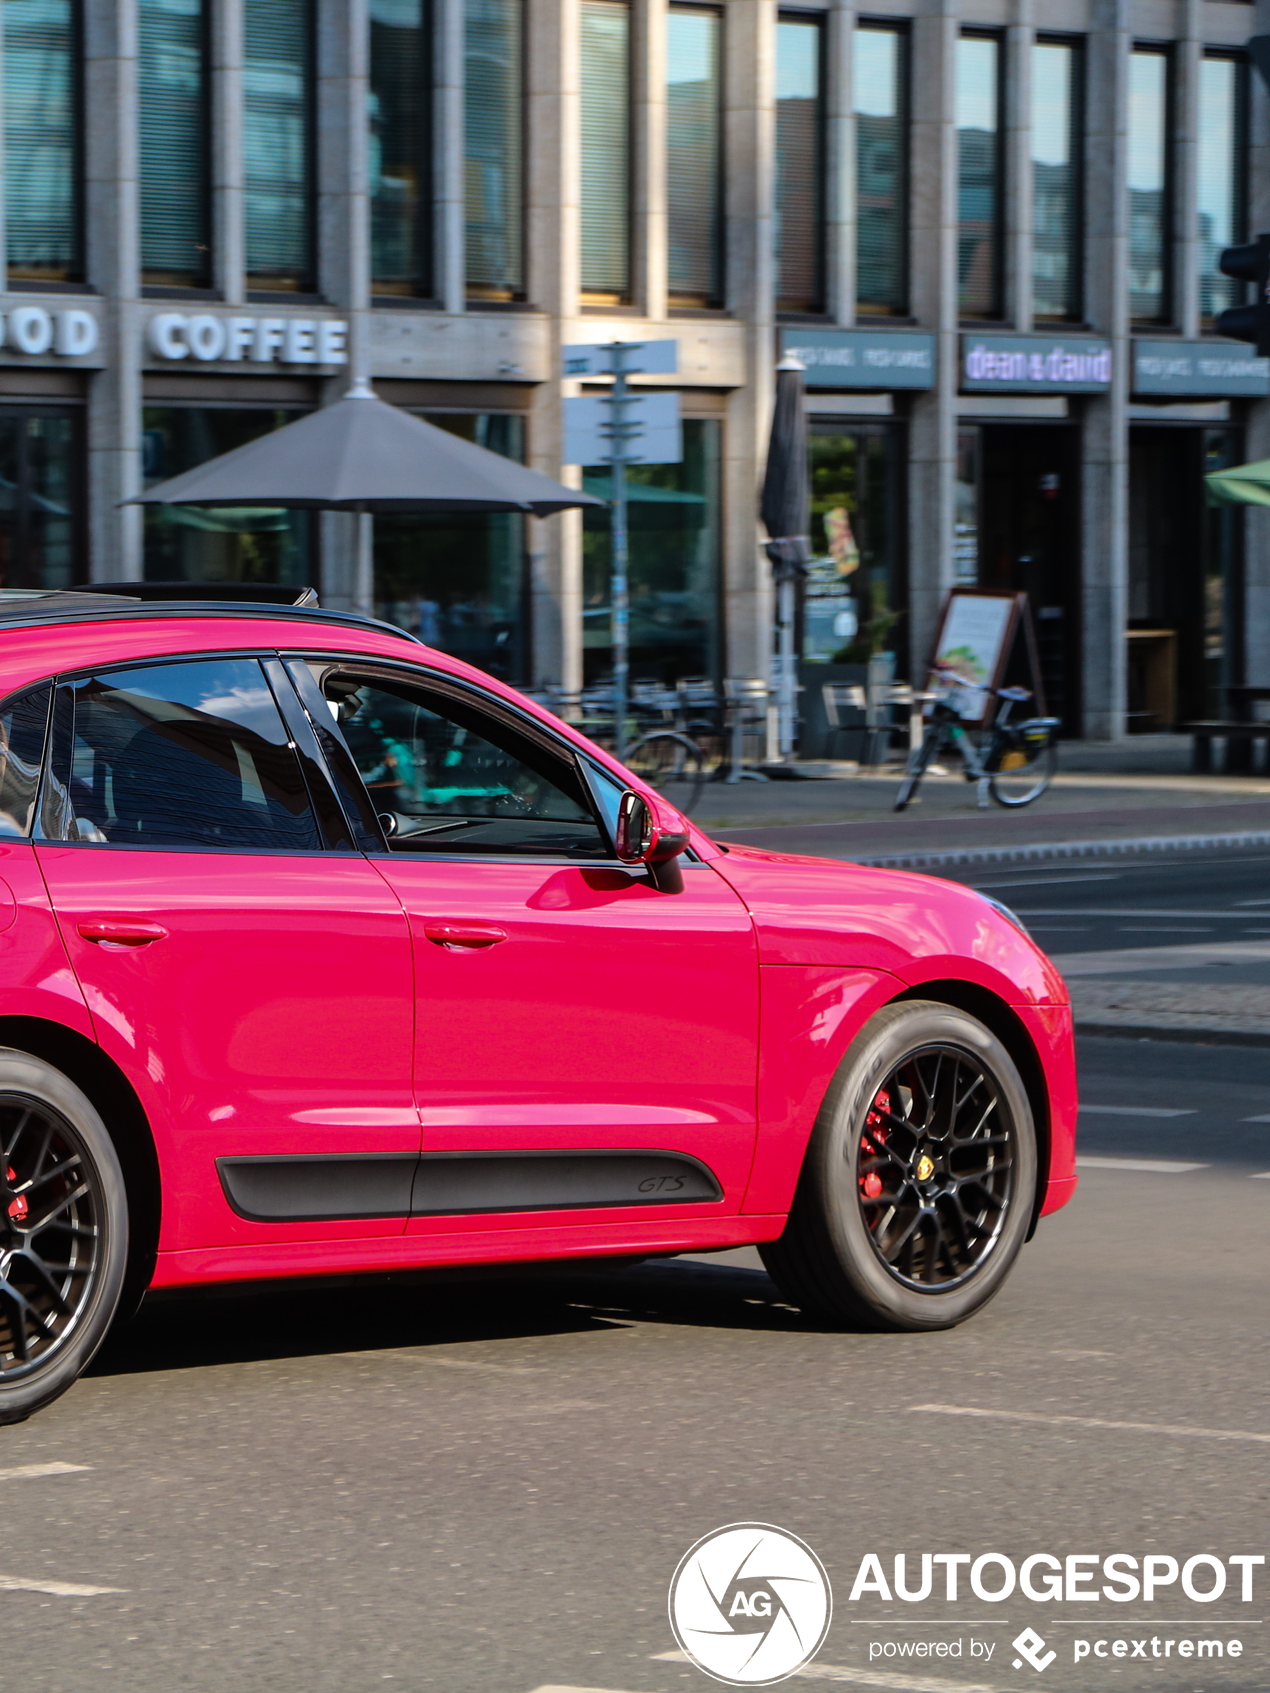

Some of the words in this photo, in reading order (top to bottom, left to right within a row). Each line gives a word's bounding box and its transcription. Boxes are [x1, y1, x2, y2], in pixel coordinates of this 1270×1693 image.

[149, 312, 348, 364] COFFEE
[966, 344, 1028, 380] dean
[1045, 347, 1112, 382] david
[637, 1176, 687, 1193] GTS
